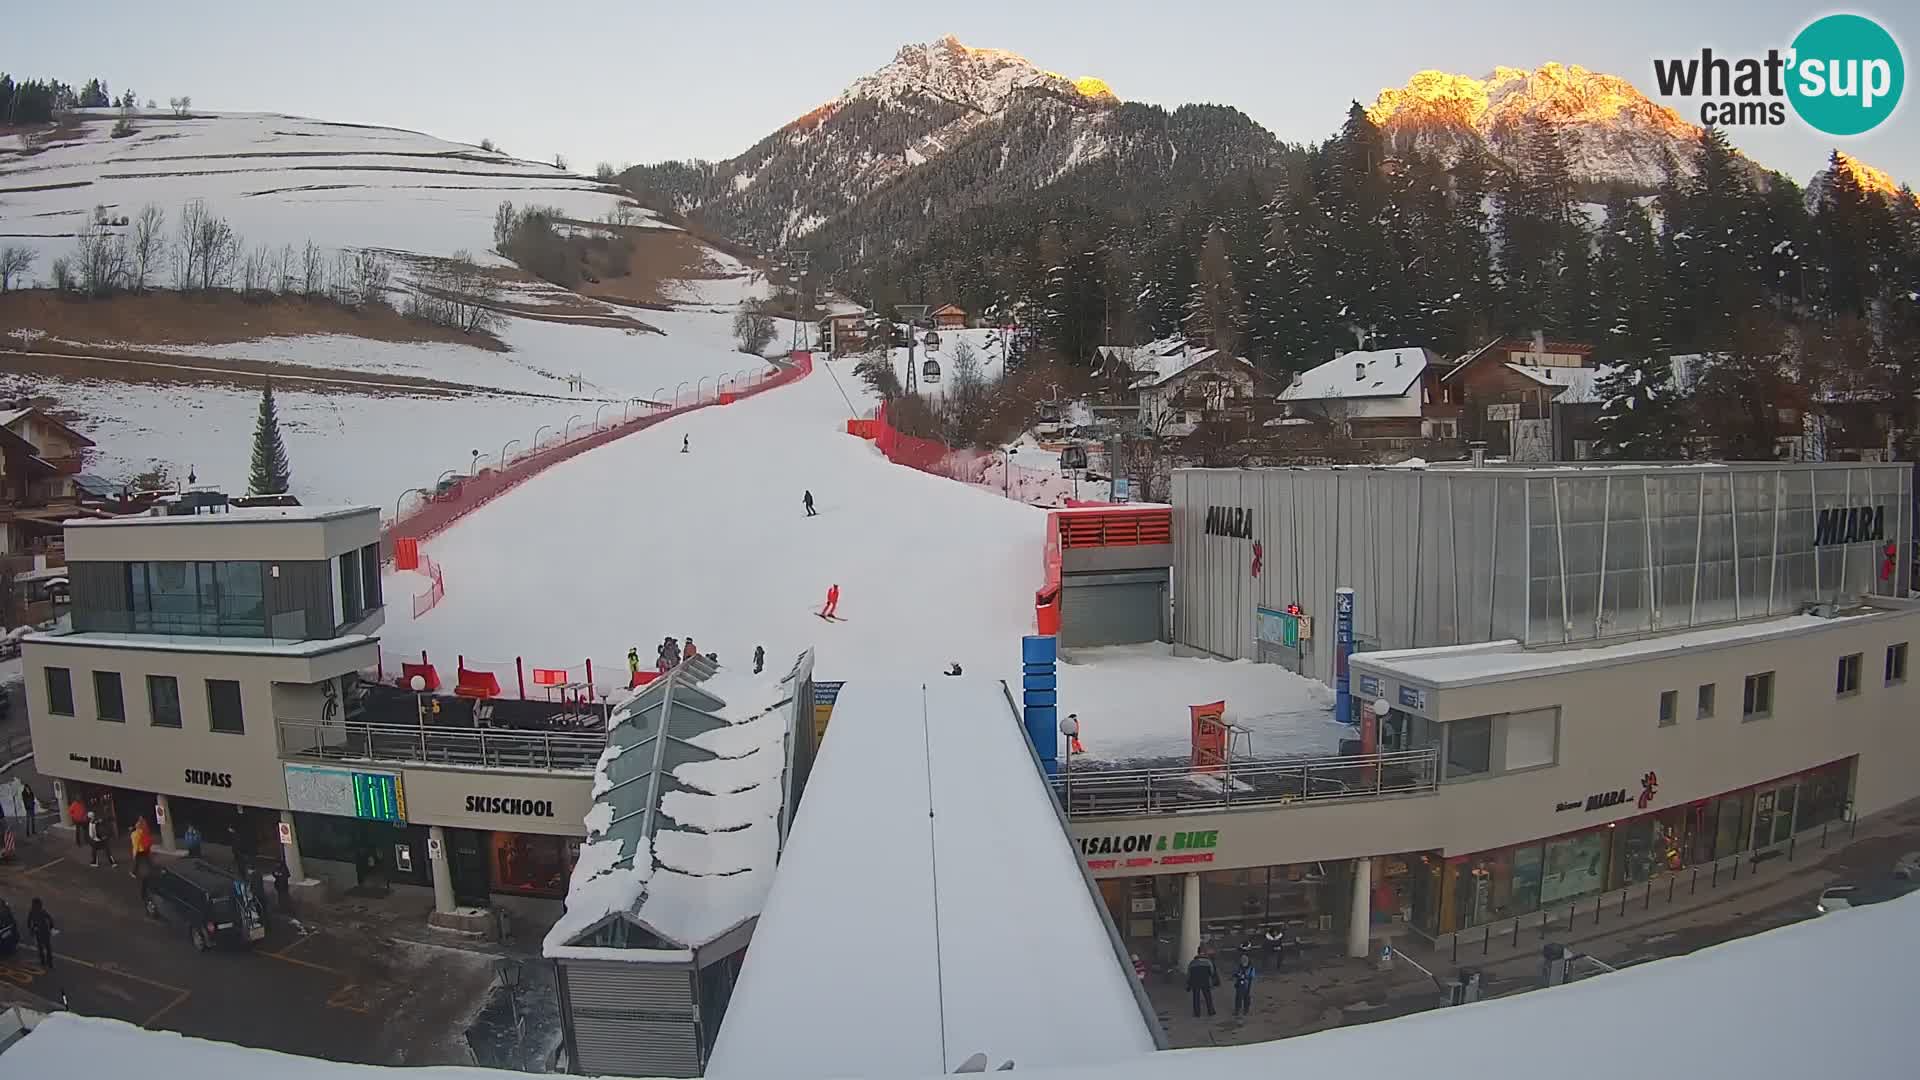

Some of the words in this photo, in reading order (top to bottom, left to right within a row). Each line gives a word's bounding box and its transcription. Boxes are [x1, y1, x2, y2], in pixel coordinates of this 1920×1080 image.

[1205, 505, 1253, 540] MIARA
[1813, 505, 1884, 546] MIARA
[90, 756, 122, 774] MIARA
[184, 768, 233, 788] SKIPASS
[465, 795, 555, 818] SKISCHOOL
[1584, 789, 1627, 812] MIARA
[1173, 830, 1219, 850] BIKE
